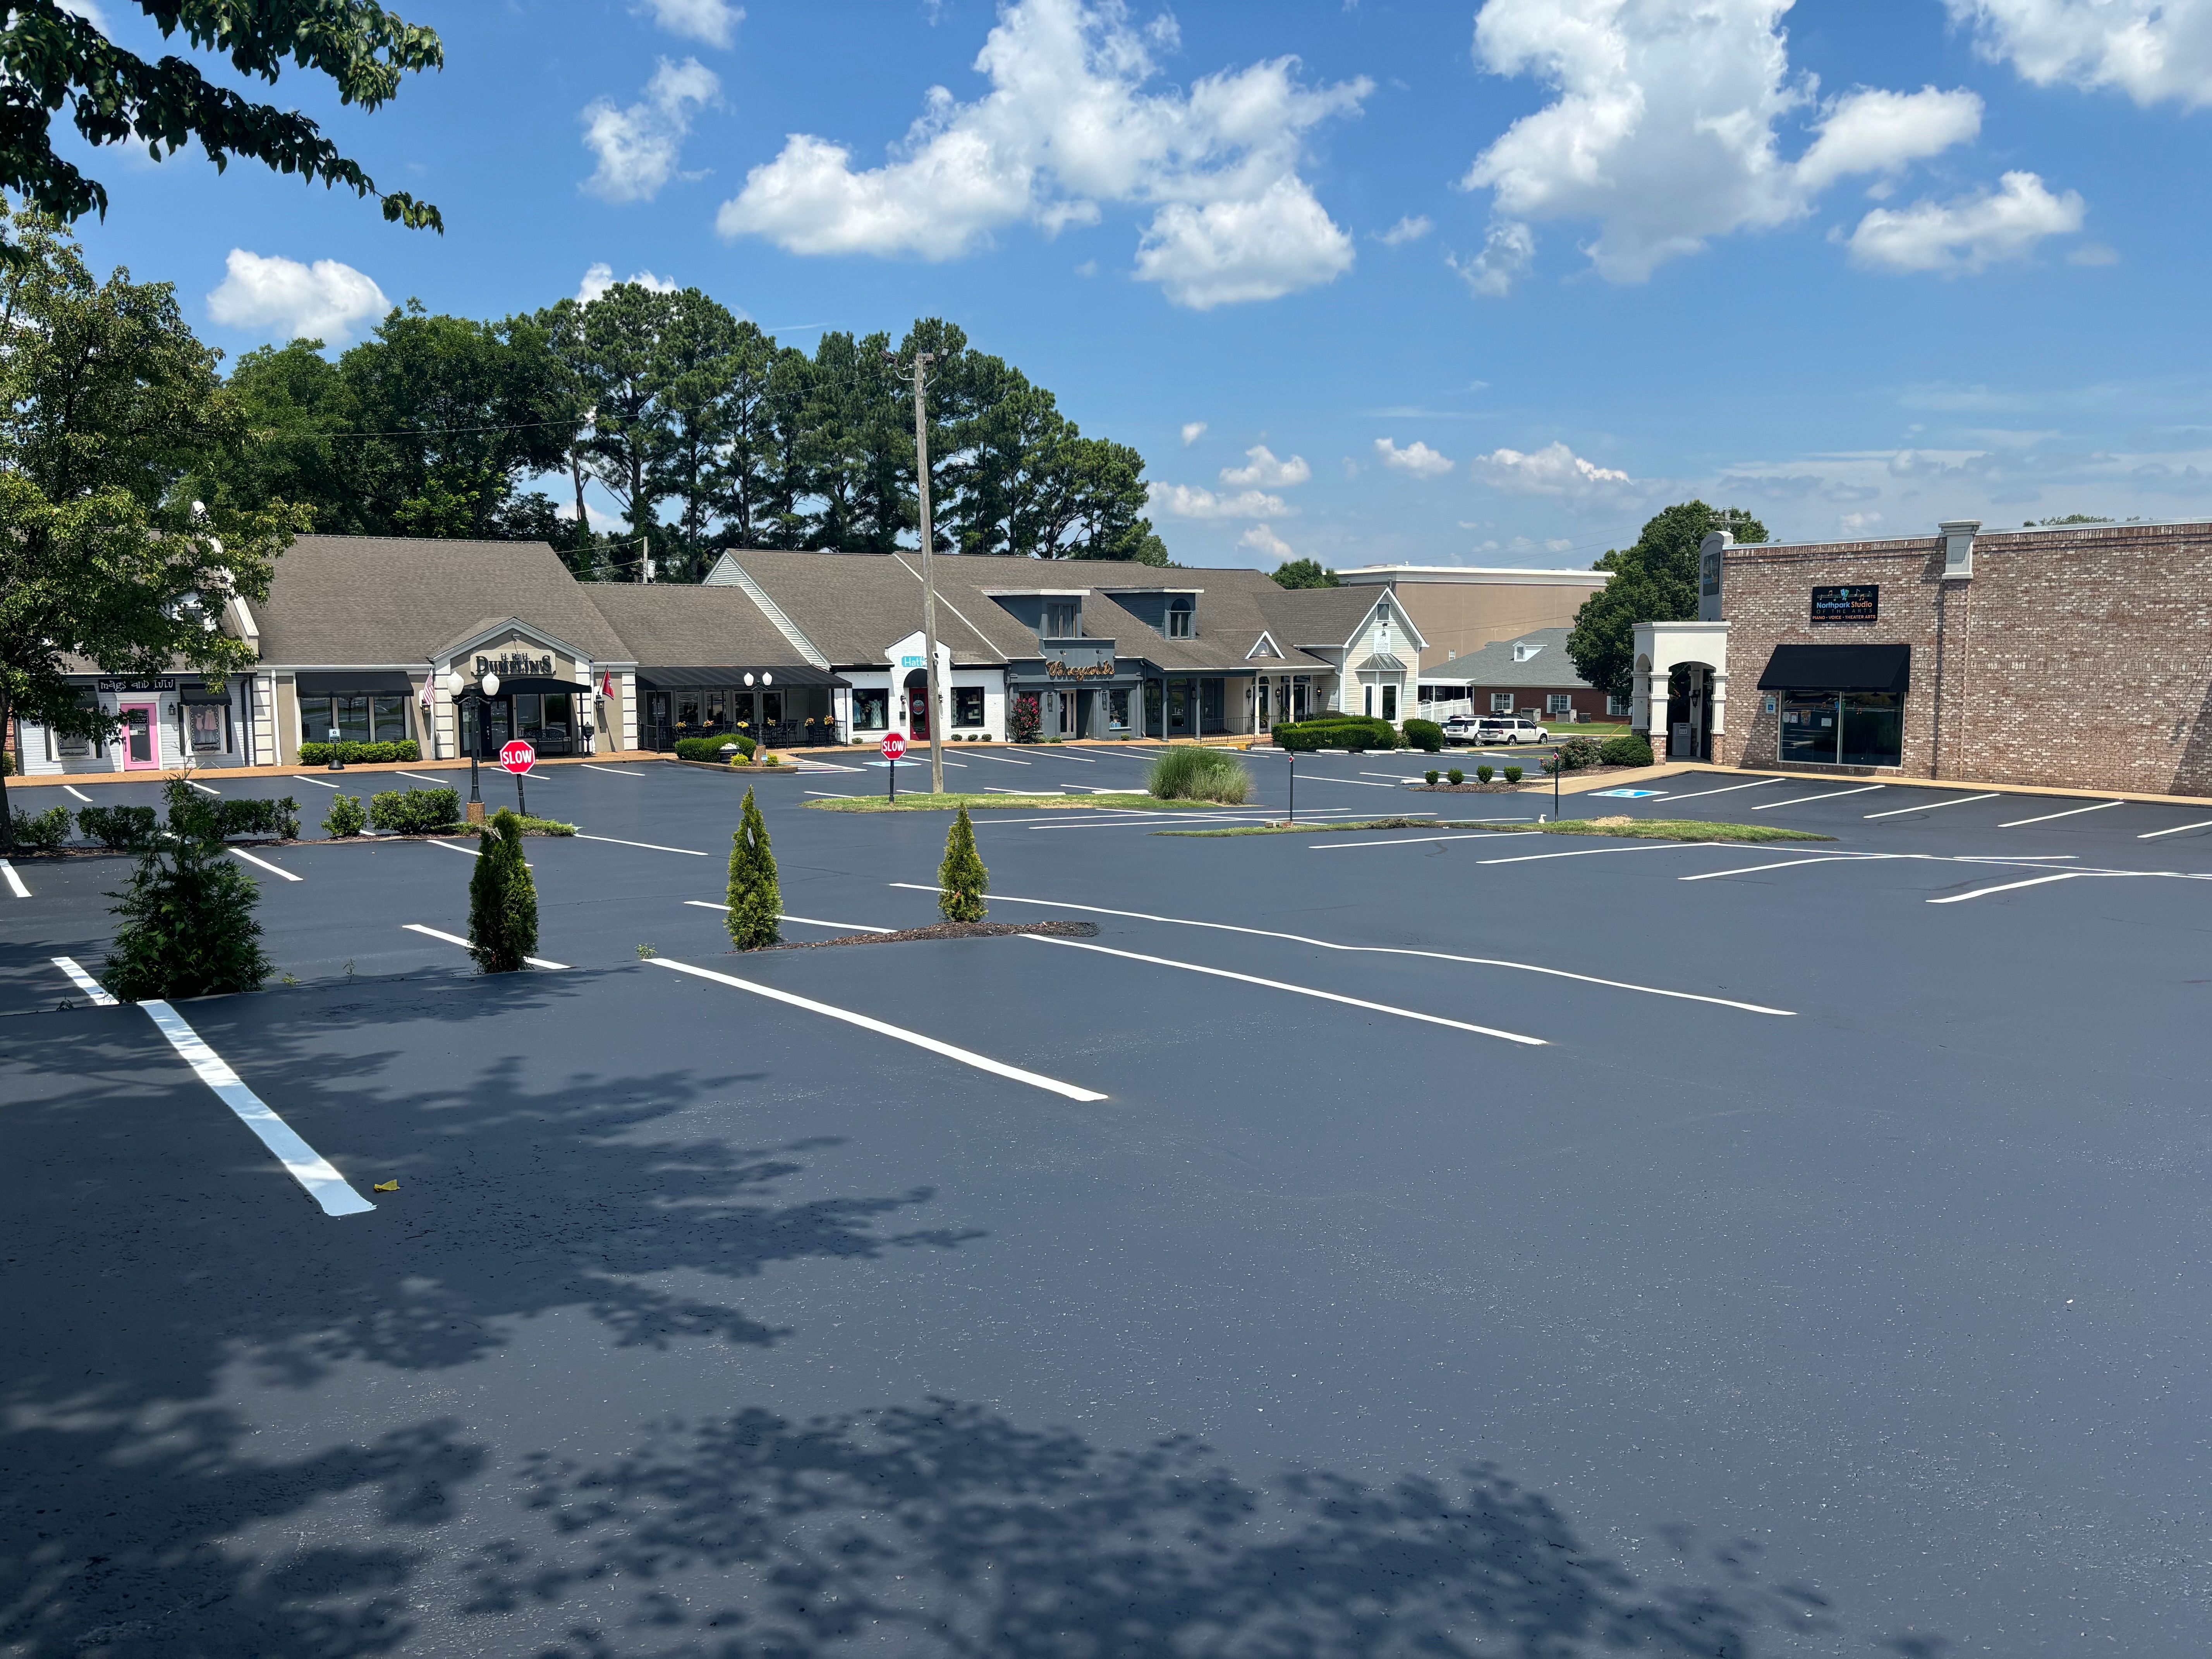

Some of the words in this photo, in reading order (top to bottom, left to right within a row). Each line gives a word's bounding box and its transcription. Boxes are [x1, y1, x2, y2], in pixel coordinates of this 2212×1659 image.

[1046, 661, 1115, 682] Vineyards
[100, 680, 126, 692] mags
[883, 740, 904, 752] SLOW
[503, 750, 532, 764] SLOW
